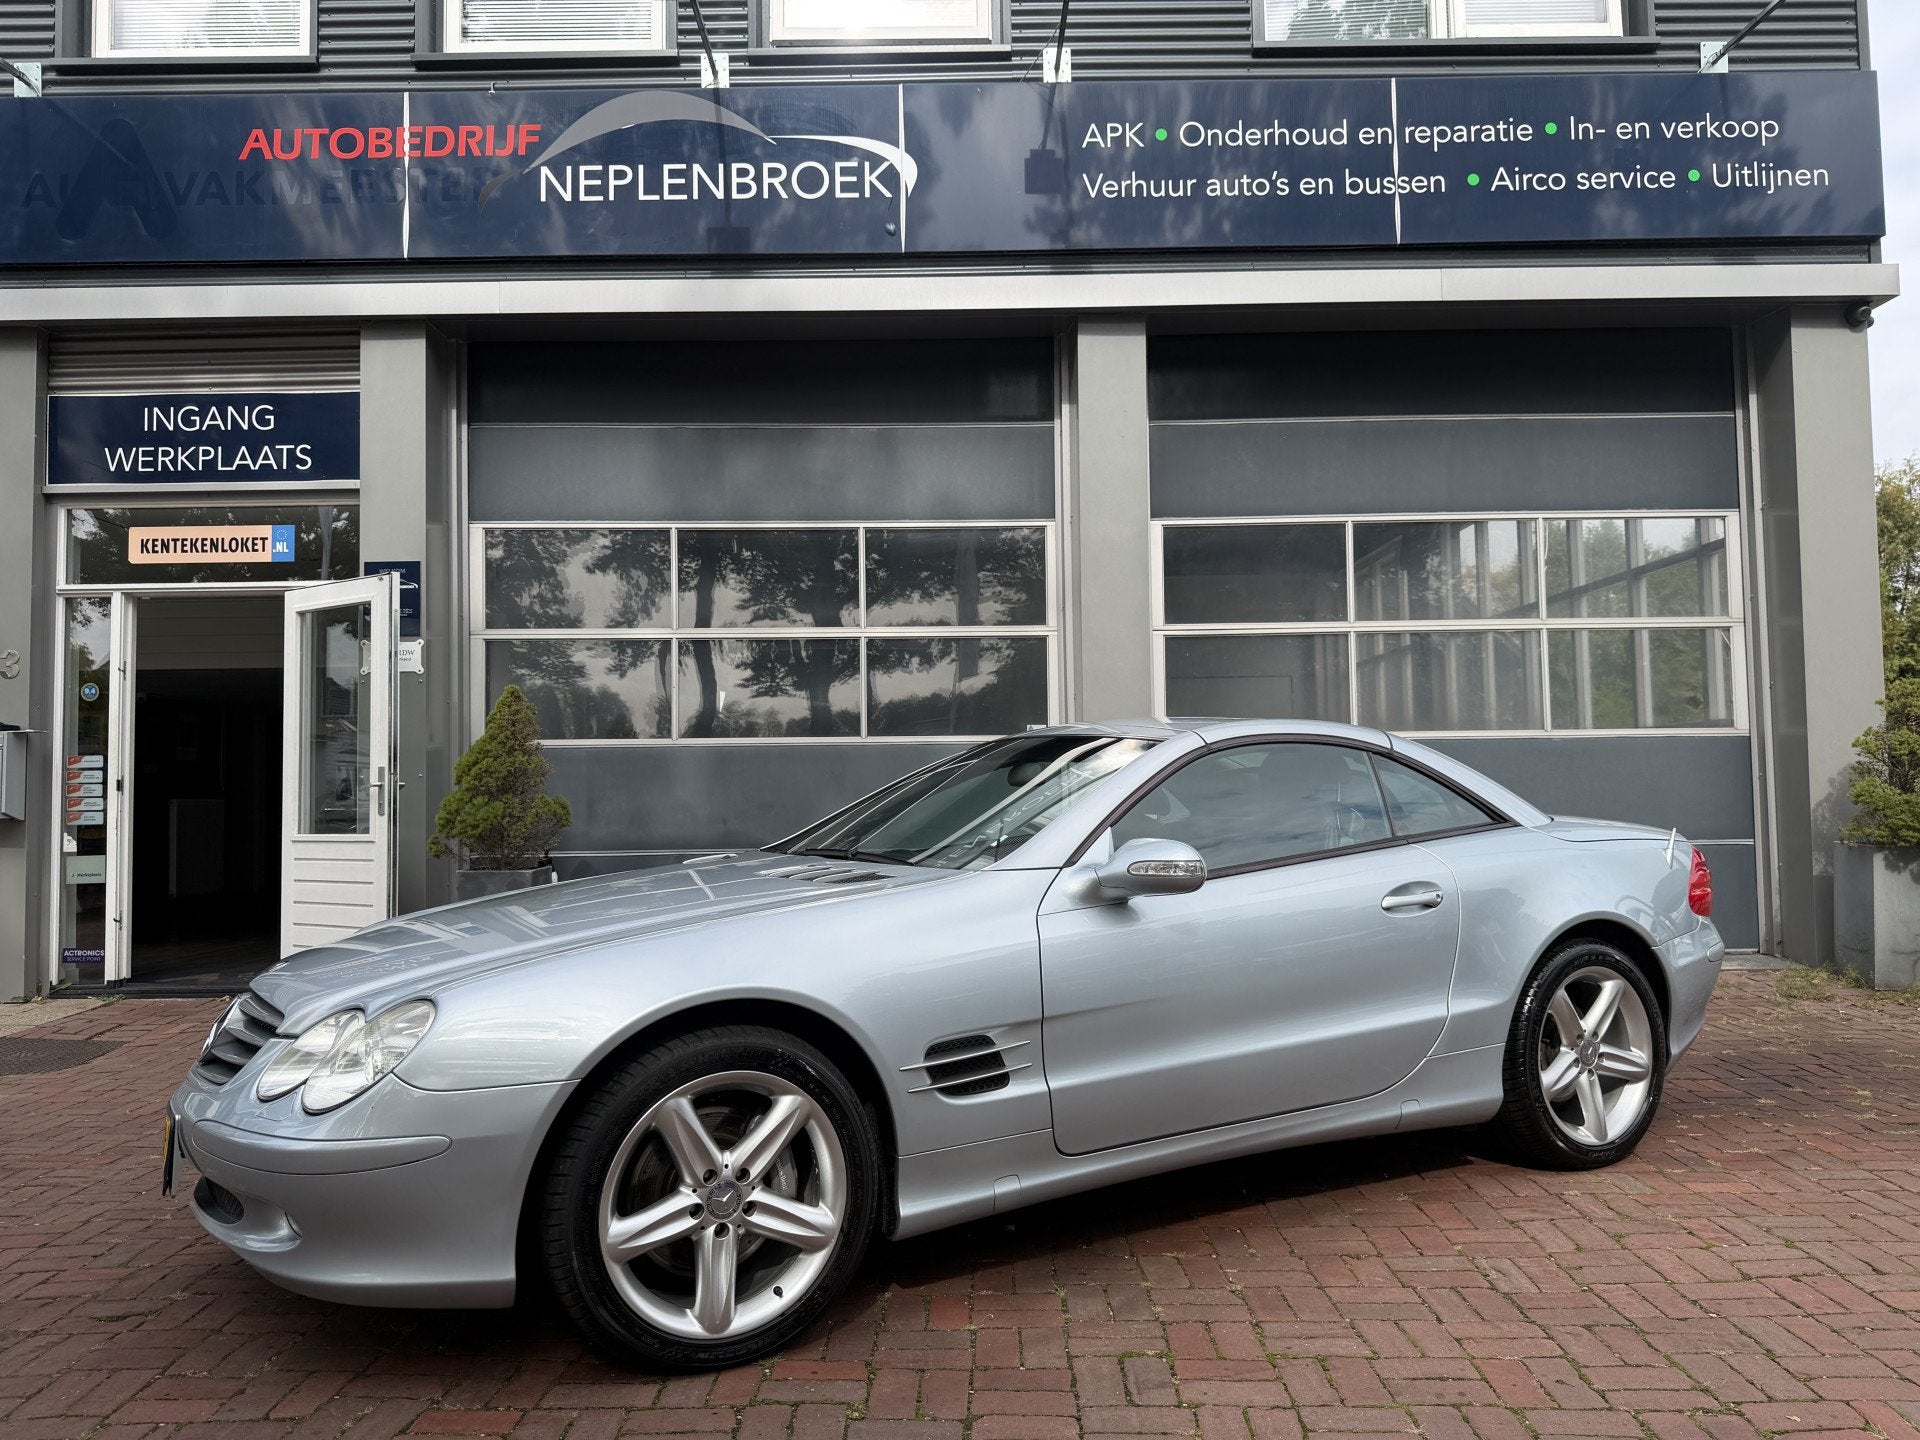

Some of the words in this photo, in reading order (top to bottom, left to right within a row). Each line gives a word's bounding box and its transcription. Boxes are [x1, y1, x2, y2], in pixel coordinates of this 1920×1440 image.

[240, 124, 541, 160] AUTOBEDRIJF
[1081, 122, 1145, 149] APK
[1179, 118, 1348, 147] Onderhoud
[1358, 127, 1393, 145] en
[1404, 117, 1533, 153] reparatie
[1570, 115, 1606, 140] In-
[1616, 122, 1650, 140] en
[1660, 112, 1779, 147] verkoop
[540, 160, 893, 202] NEPLENBROEK
[1082, 170, 1197, 199] Verhuur
[1299, 177, 1334, 196] en
[1345, 168, 1446, 195] bussen
[1490, 166, 1566, 192] Airco
[1576, 164, 1676, 190] service
[1712, 160, 1829, 195] Uitlijnen
[144, 404, 275, 432] INGANG
[104, 444, 312, 472] WERKPLAATS
[140, 536, 269, 554] KENTEKENLOKET
[64, 949, 105, 957] ACTRONICS
